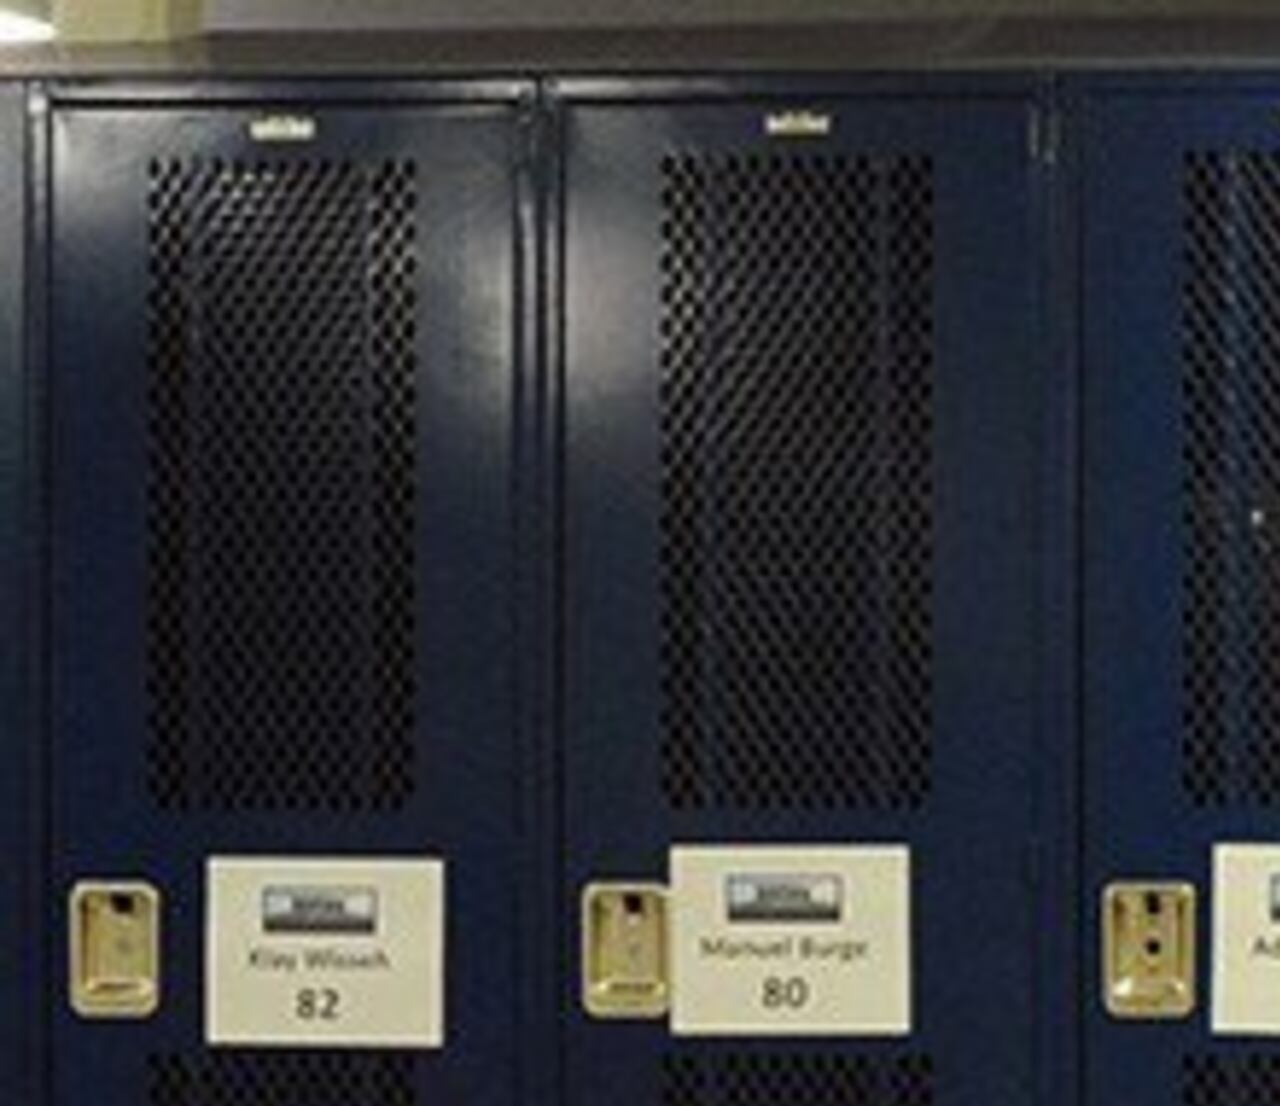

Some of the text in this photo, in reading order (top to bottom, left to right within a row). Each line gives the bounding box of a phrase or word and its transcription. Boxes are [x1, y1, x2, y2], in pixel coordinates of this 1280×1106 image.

[700, 935, 793, 959] Manuel
[295, 987, 341, 1021] 82
[761, 975, 810, 1010] 80
